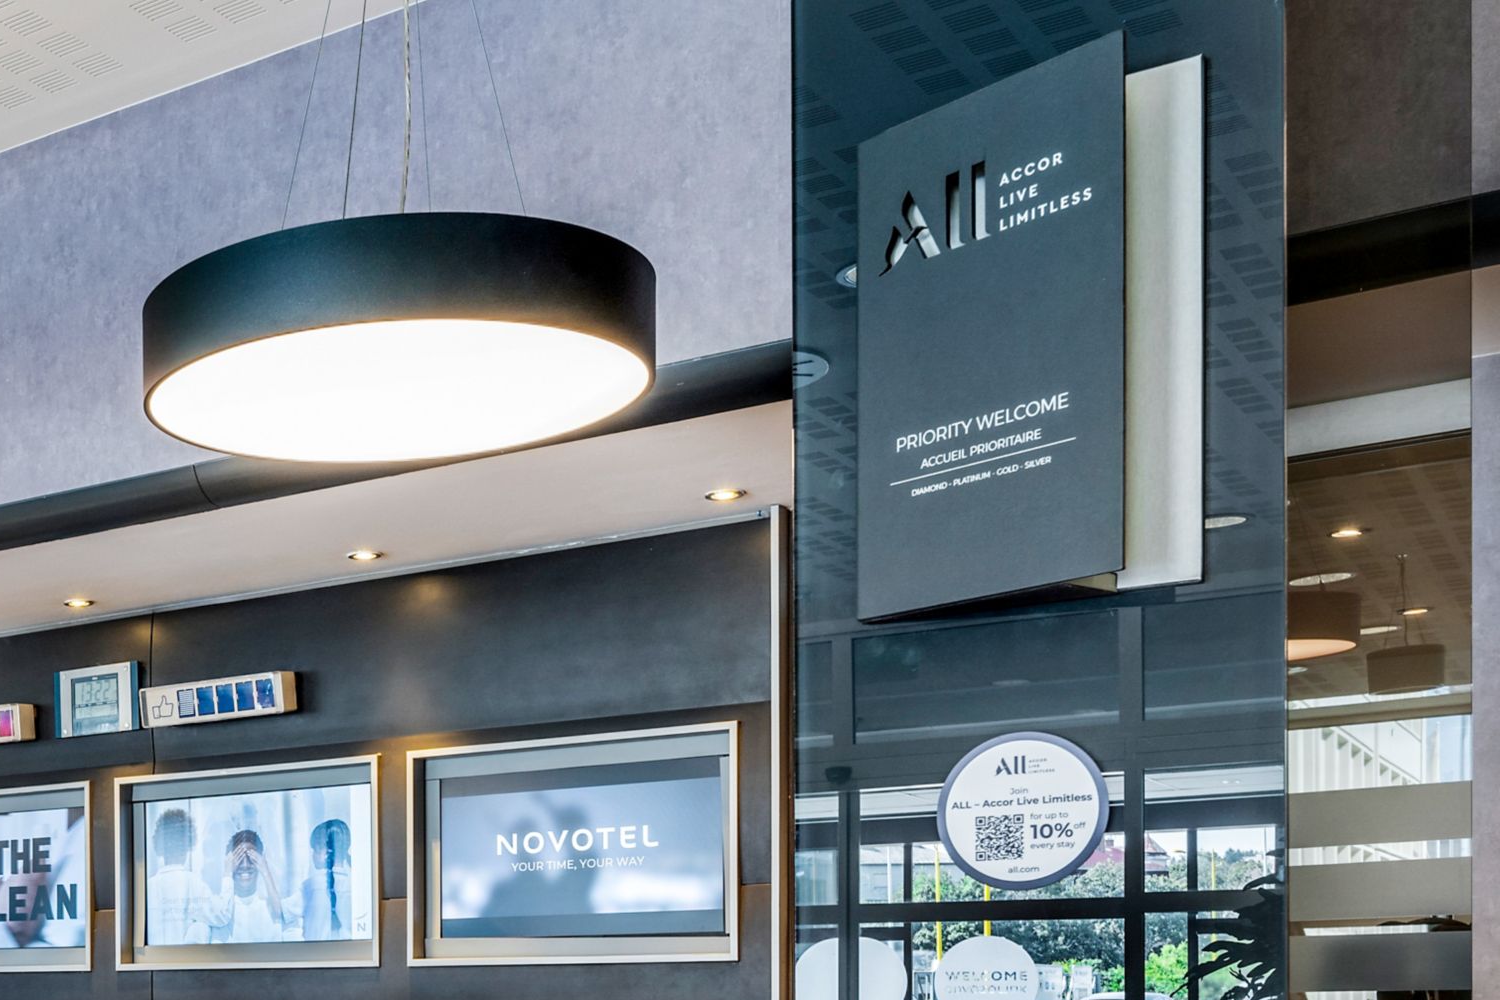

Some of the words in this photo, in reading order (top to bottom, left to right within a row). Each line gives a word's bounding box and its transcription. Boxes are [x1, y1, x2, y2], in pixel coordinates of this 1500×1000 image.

[999, 152, 1063, 187] ACCOR
[999, 183, 1039, 209] LIVE
[999, 187, 1093, 232] LIMITLESS
[896, 418, 973, 453] PRIORITY
[975, 391, 1070, 431] WELCOME
[920, 449, 968, 470] ACCUEIL
[970, 428, 1043, 456] PRIORITAIRE
[911, 482, 949, 497] DIAMOND
[953, 471, 991, 487] PLATINUM
[996, 464, 1019, 476] GOLD
[1024, 455, 1052, 470] SILVER
[1010, 787, 1029, 796] Join
[952, 801, 971, 810] ALL
[983, 798, 1013, 808] Accor
[1017, 795, 1039, 806] Live
[1042, 793, 1093, 804] Limitless
[1030, 812, 1041, 820] for
[1045, 812, 1057, 820] up
[1030, 822, 1074, 839] 10%
[1074, 821, 1086, 830] off
[496, 825, 660, 856] NOVOTEL
[1030, 842, 1054, 850] every
[1056, 840, 1076, 849] stay
[512, 861, 544, 873] YOUR
[547, 859, 577, 871] TIME,
[580, 857, 613, 869] YOUR
[616, 855, 645, 867] WAY
[1008, 865, 1040, 874] all.com
